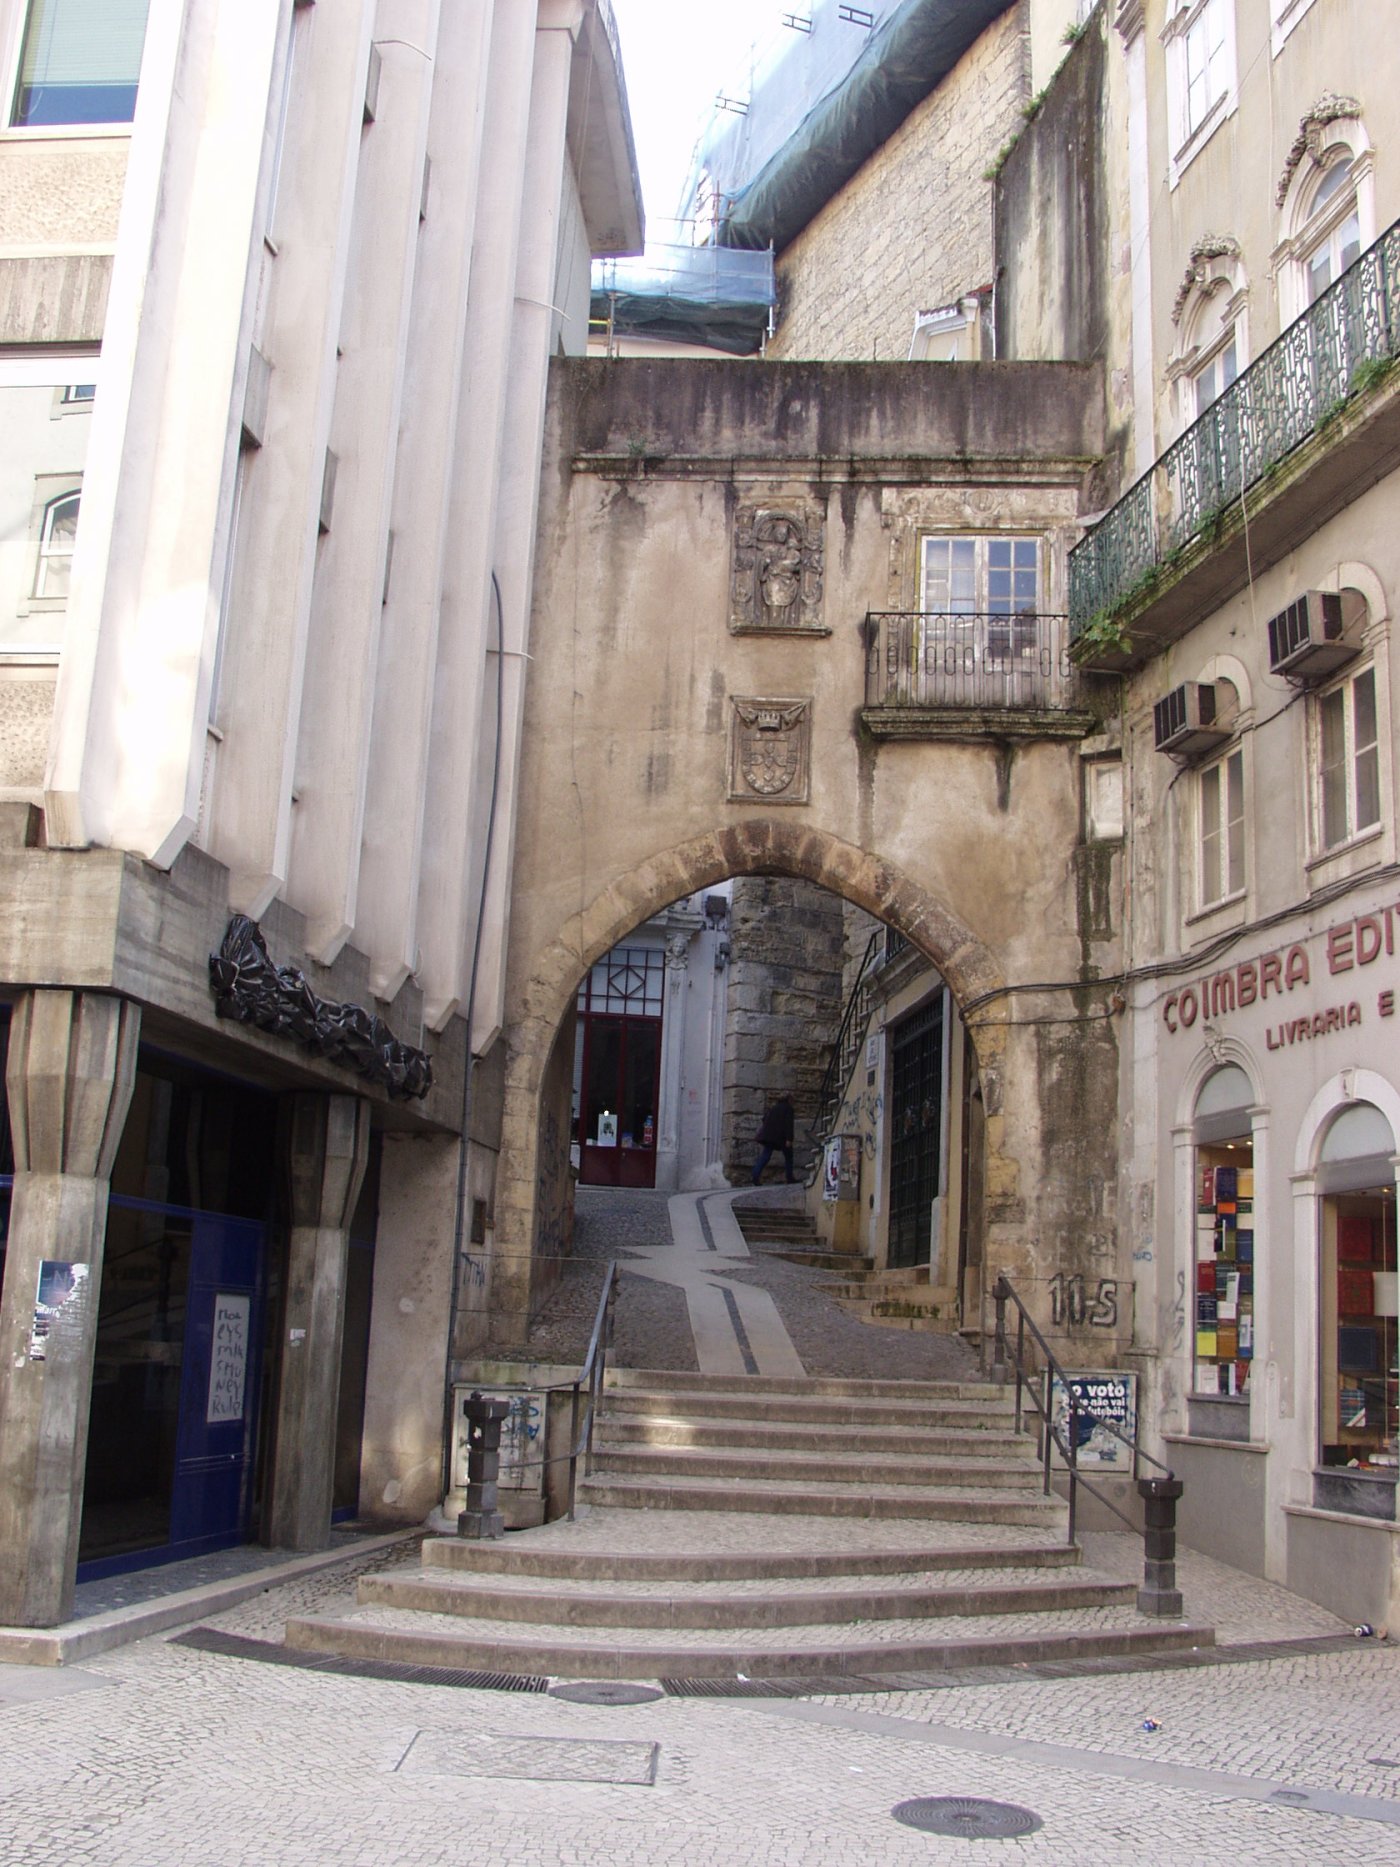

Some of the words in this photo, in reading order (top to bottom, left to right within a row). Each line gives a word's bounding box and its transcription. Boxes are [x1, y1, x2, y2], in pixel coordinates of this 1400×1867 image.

[1163, 945, 1309, 1034] COIMBRA
[1265, 1001, 1361, 1051] LIVRARIA
[1378, 989, 1395, 1018] E
[1086, 1382, 1125, 1398] voto
[1110, 1397, 1125, 1407] vai
